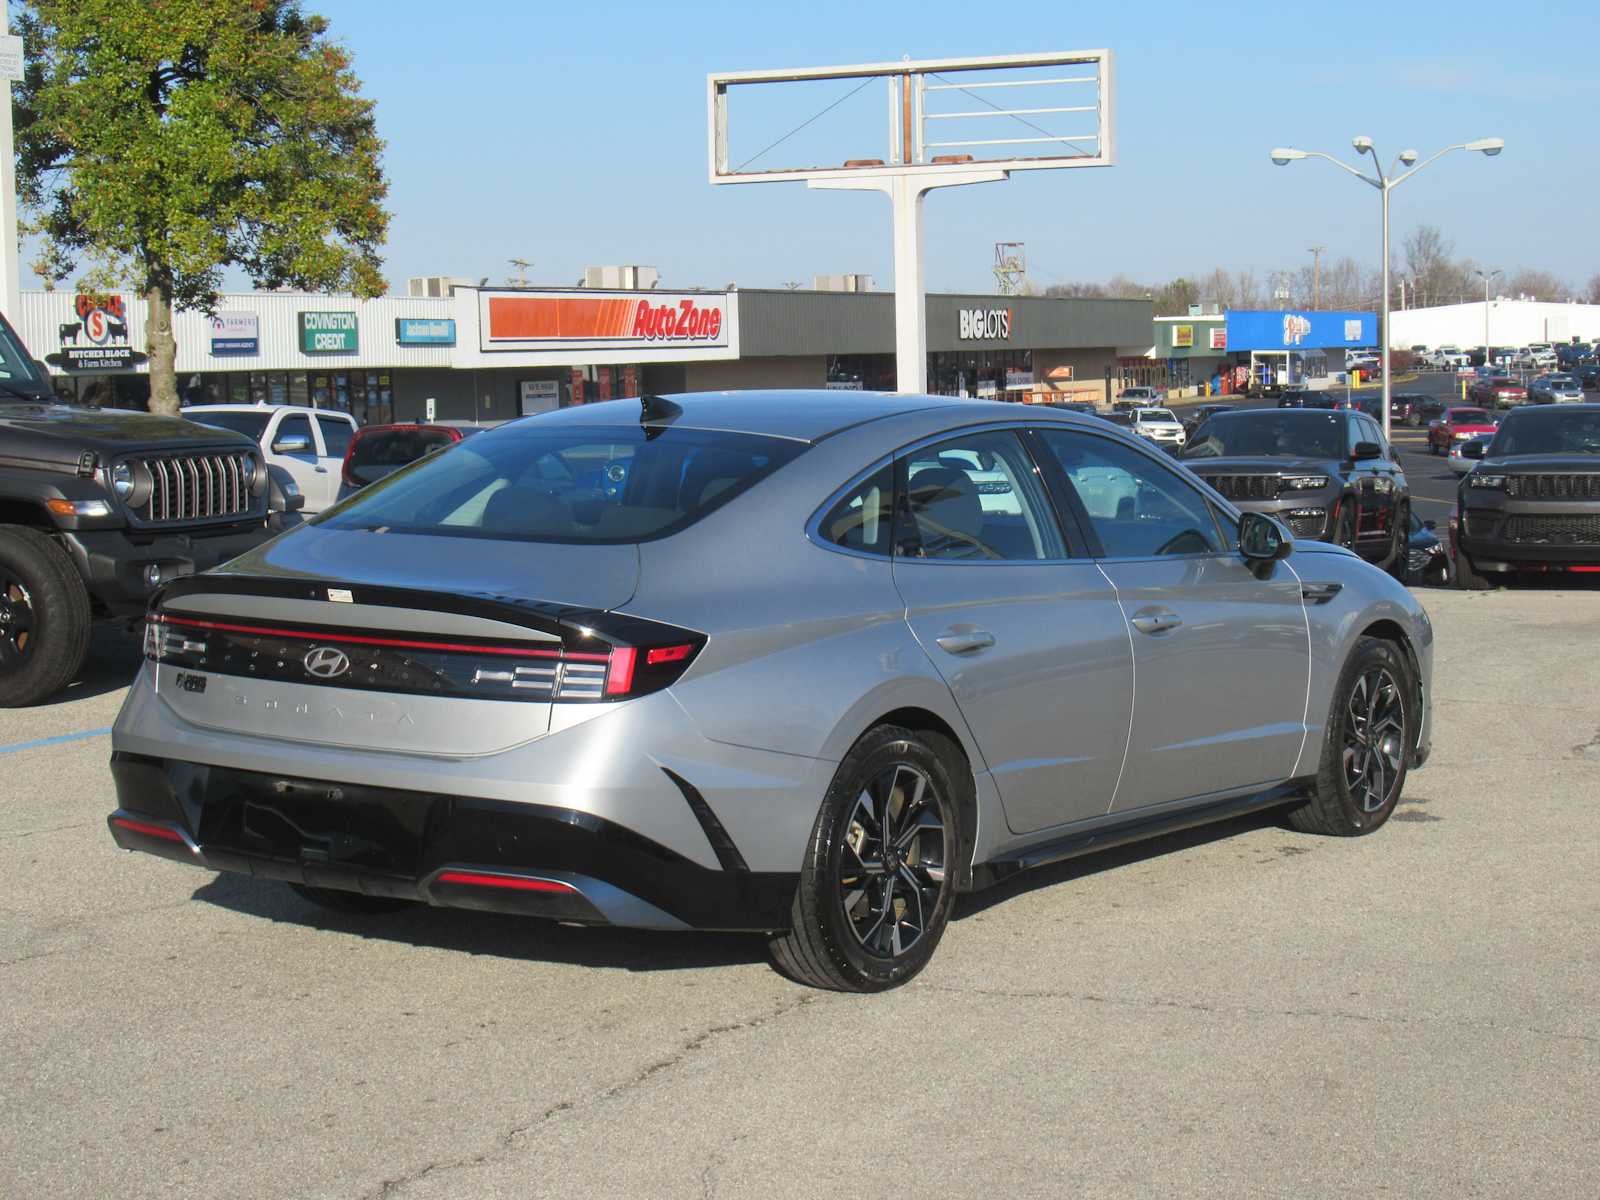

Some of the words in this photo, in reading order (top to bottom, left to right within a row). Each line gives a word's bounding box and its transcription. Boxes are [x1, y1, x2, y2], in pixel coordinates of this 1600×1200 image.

[92, 311, 103, 336] S
[304, 313, 355, 329] COVINGTON
[631, 299, 721, 339] AutoZone
[314, 333, 345, 350] CREDIT
